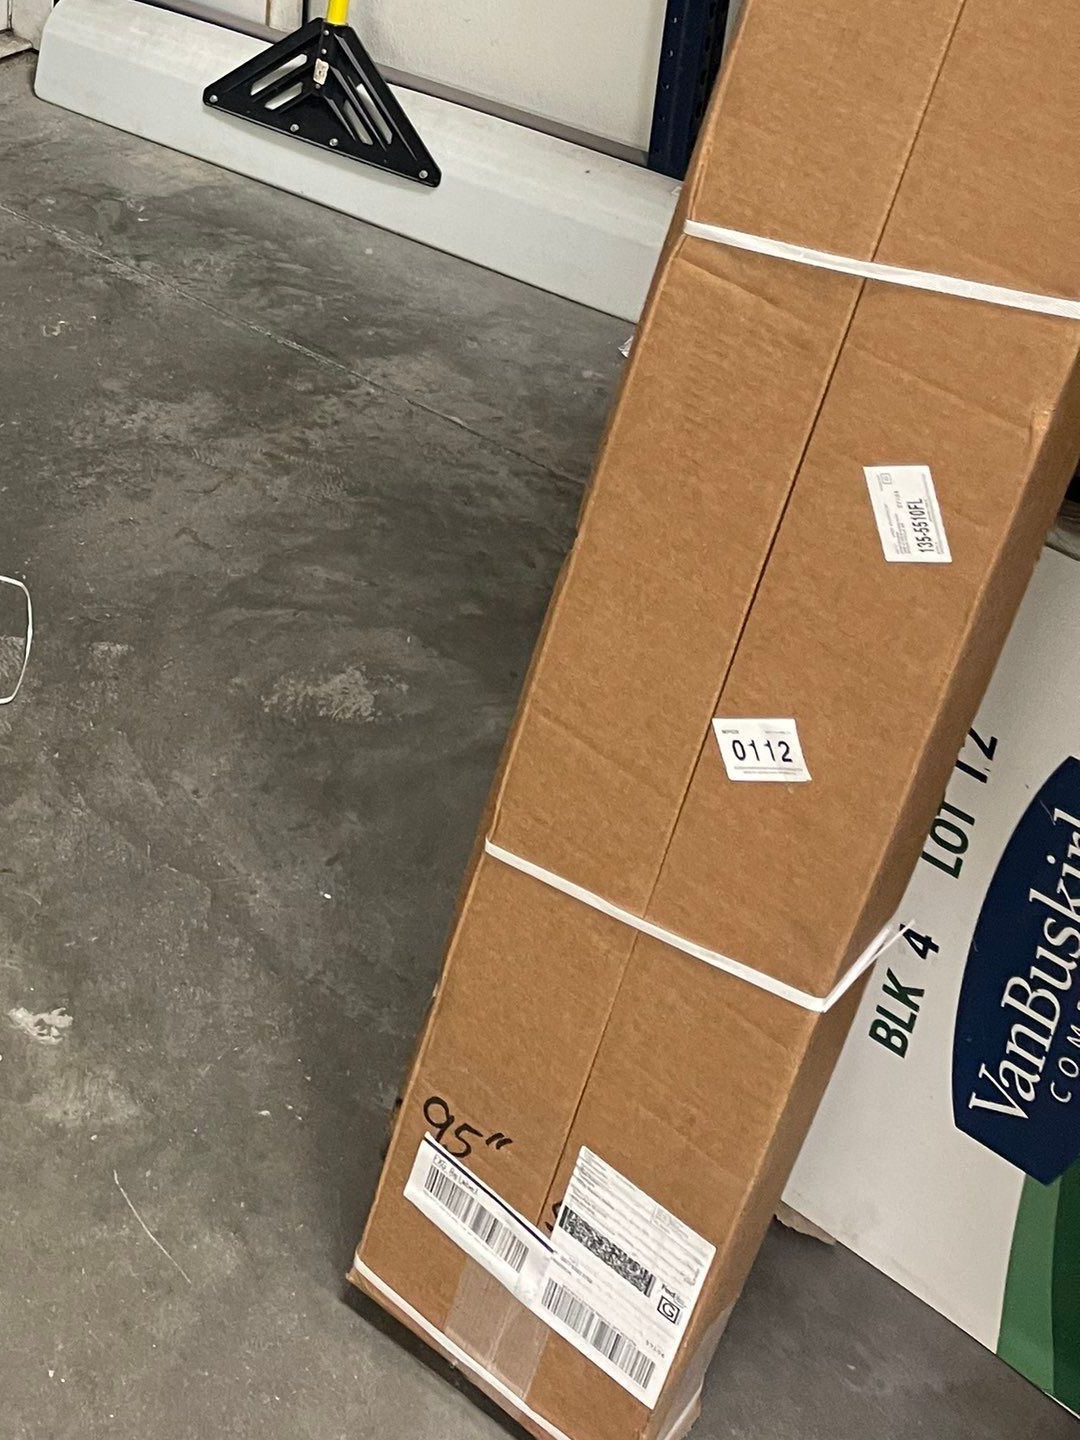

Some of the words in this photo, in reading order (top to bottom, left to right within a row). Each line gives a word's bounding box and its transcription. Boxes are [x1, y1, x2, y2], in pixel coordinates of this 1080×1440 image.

[906, 498, 935, 553] 135-5510FL
[732, 739, 793, 763] 0112
[868, 968, 925, 1059] BLK
[899, 922, 940, 960] 4
[921, 789, 975, 880] LOT
[956, 726, 999, 785] 12
[1050, 1000, 1080, 1104] COM
[423, 1096, 513, 1159] 95"
